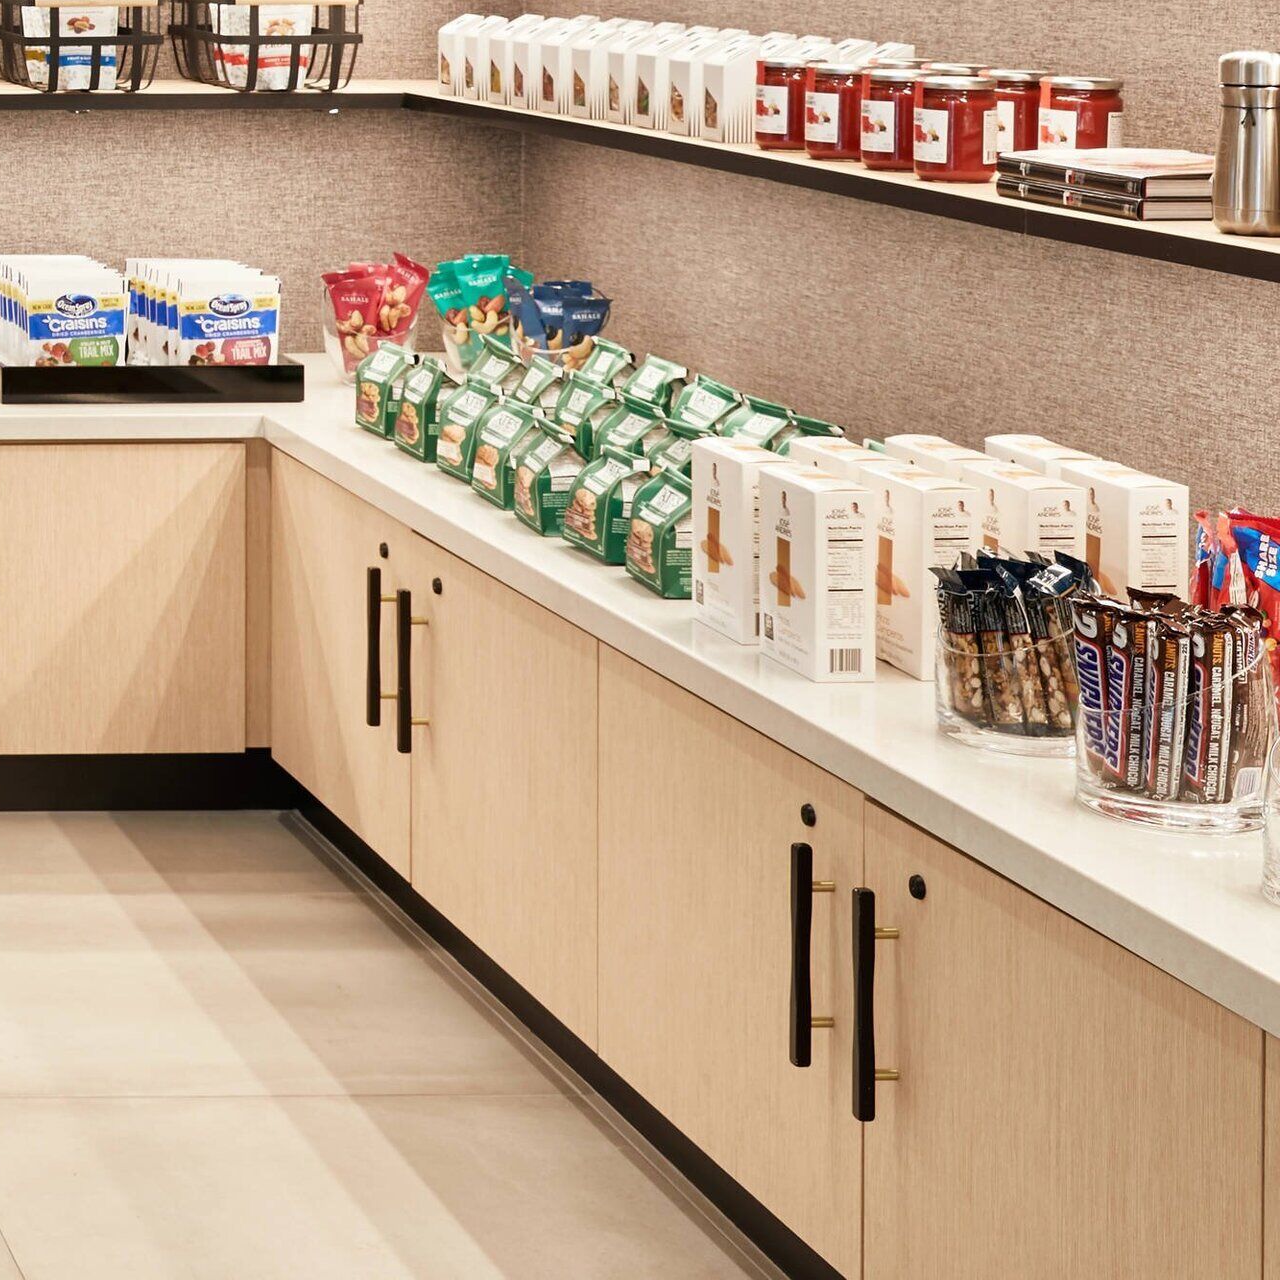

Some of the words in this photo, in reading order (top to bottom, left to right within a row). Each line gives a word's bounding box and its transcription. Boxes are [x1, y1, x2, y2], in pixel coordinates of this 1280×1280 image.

[48, 316, 107, 332] Craisins
[201, 316, 260, 333] Craisins
[79, 346, 98, 358] TRAIL
[100, 345, 114, 356] MIX
[1255, 534, 1271, 579] SHARE
[1266, 546, 1278, 578] SIZE
[1076, 640, 1106, 758] SNICKERS
